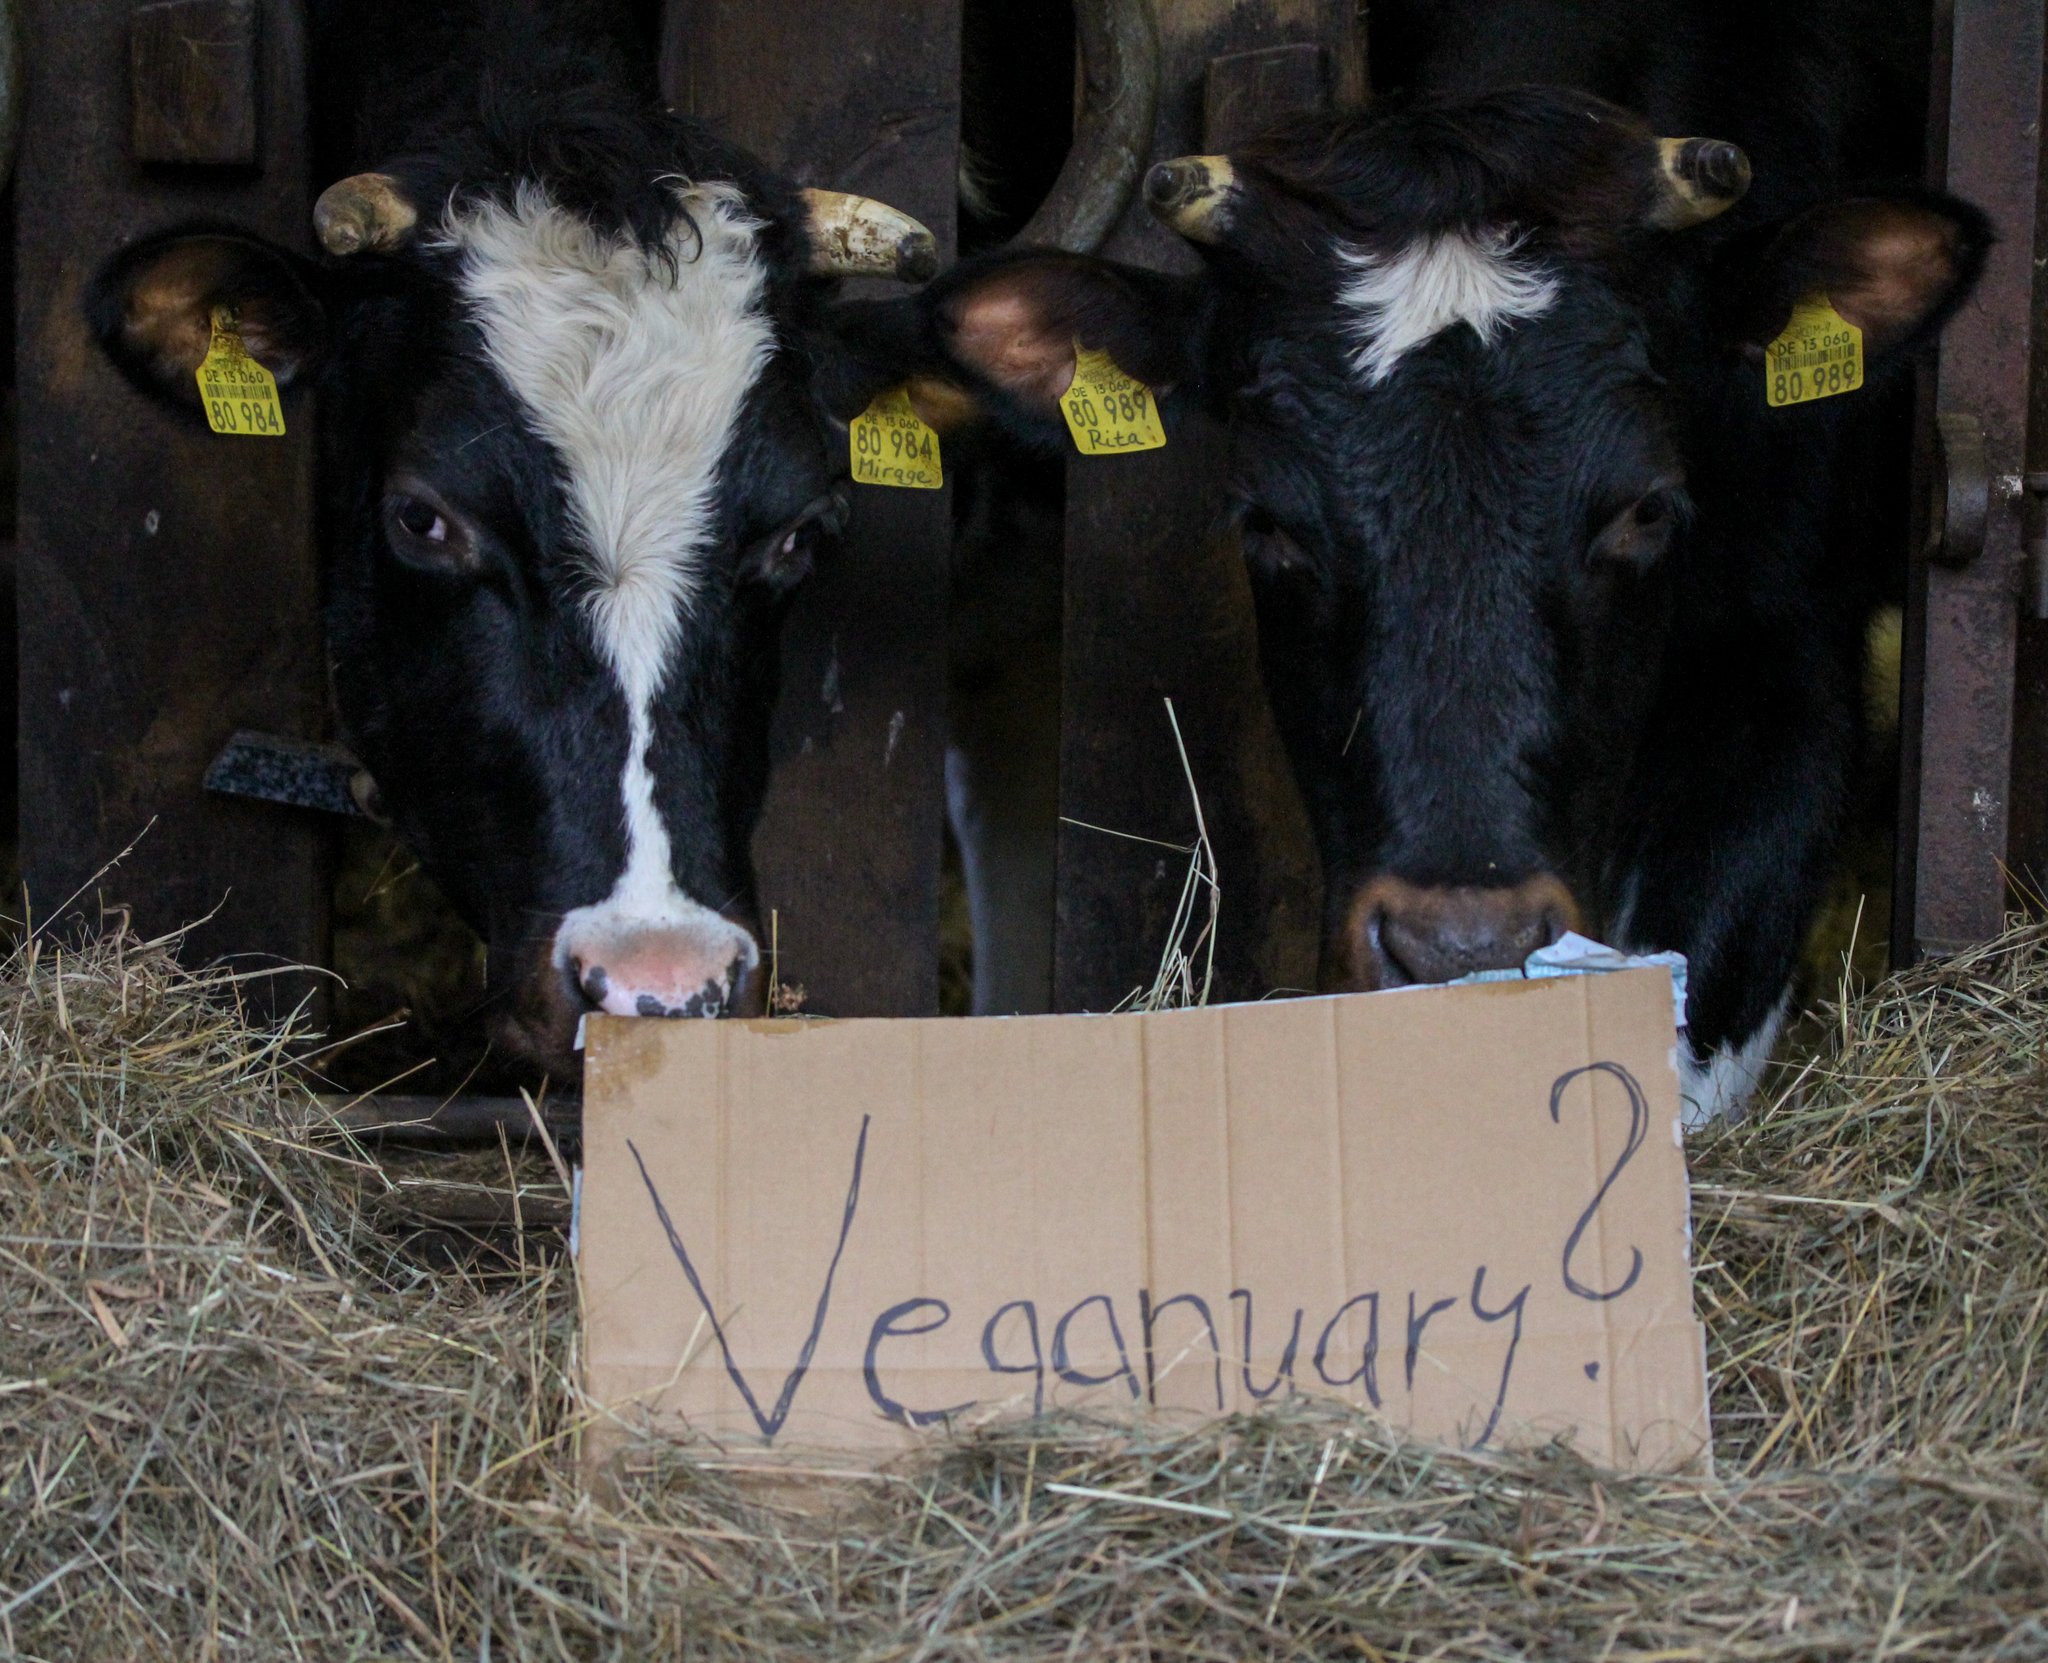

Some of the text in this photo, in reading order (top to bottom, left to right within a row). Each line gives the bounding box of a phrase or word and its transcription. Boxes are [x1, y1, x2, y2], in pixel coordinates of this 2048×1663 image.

[1778, 331, 1850, 355] DE 13 060
[205, 369, 264, 383] DE 13 060
[1072, 379, 1131, 398] DE 13 060
[1774, 360, 1856, 403] 80 989
[211, 400, 280, 432] 80 984
[865, 412, 919, 430] DE 13 060
[1068, 388, 1147, 427] 80 989
[857, 423, 933, 461] 80 984
[1087, 428, 1145, 450] Rita
[857, 455, 932, 486] Mirage
[627, 1060, 1649, 1449] Veganuary?
